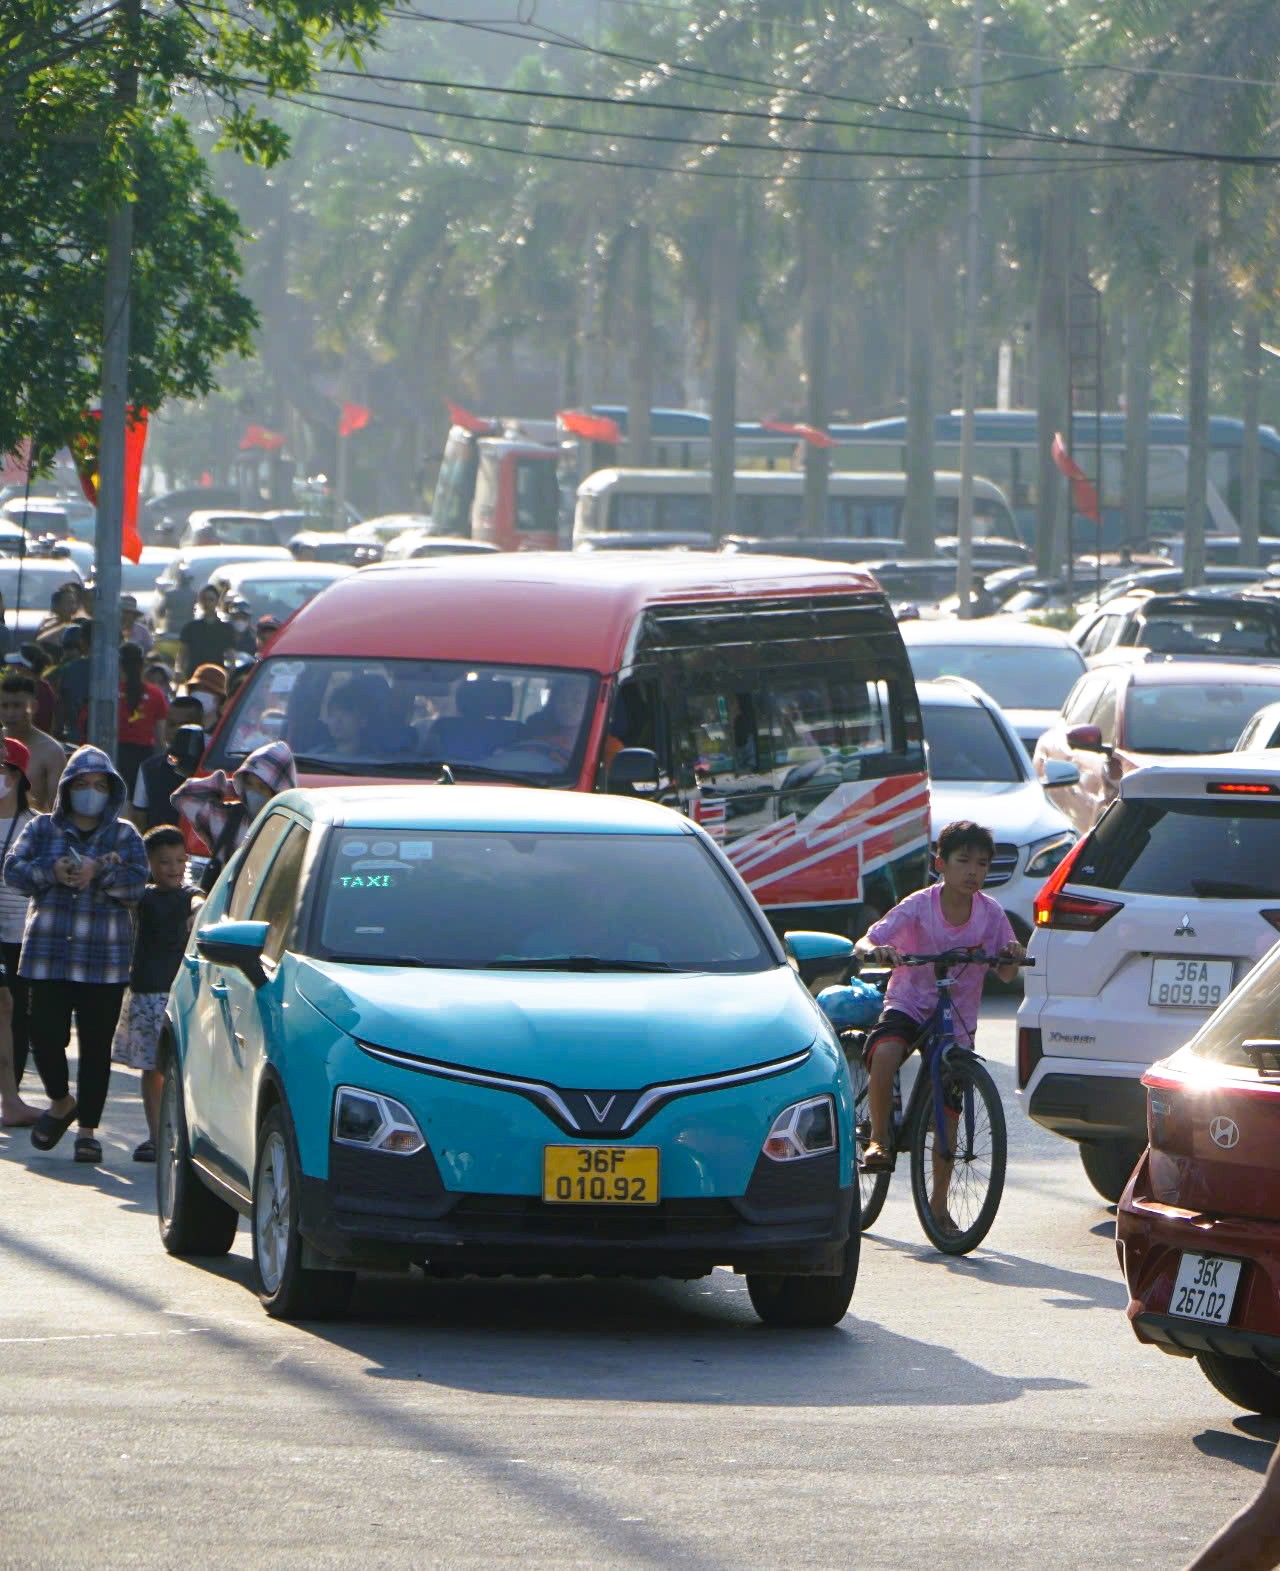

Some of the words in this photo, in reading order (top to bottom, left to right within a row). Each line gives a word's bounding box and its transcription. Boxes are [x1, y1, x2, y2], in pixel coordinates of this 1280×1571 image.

[340, 875, 391, 887] TAXI
[1175, 961, 1208, 982] 36A
[1158, 983, 1221, 1004] 809.99
[577, 1149, 625, 1173] 36F
[556, 1176, 646, 1201] 010.92
[1193, 1258, 1223, 1288] 36K
[1176, 1286, 1225, 1320] 267.02
